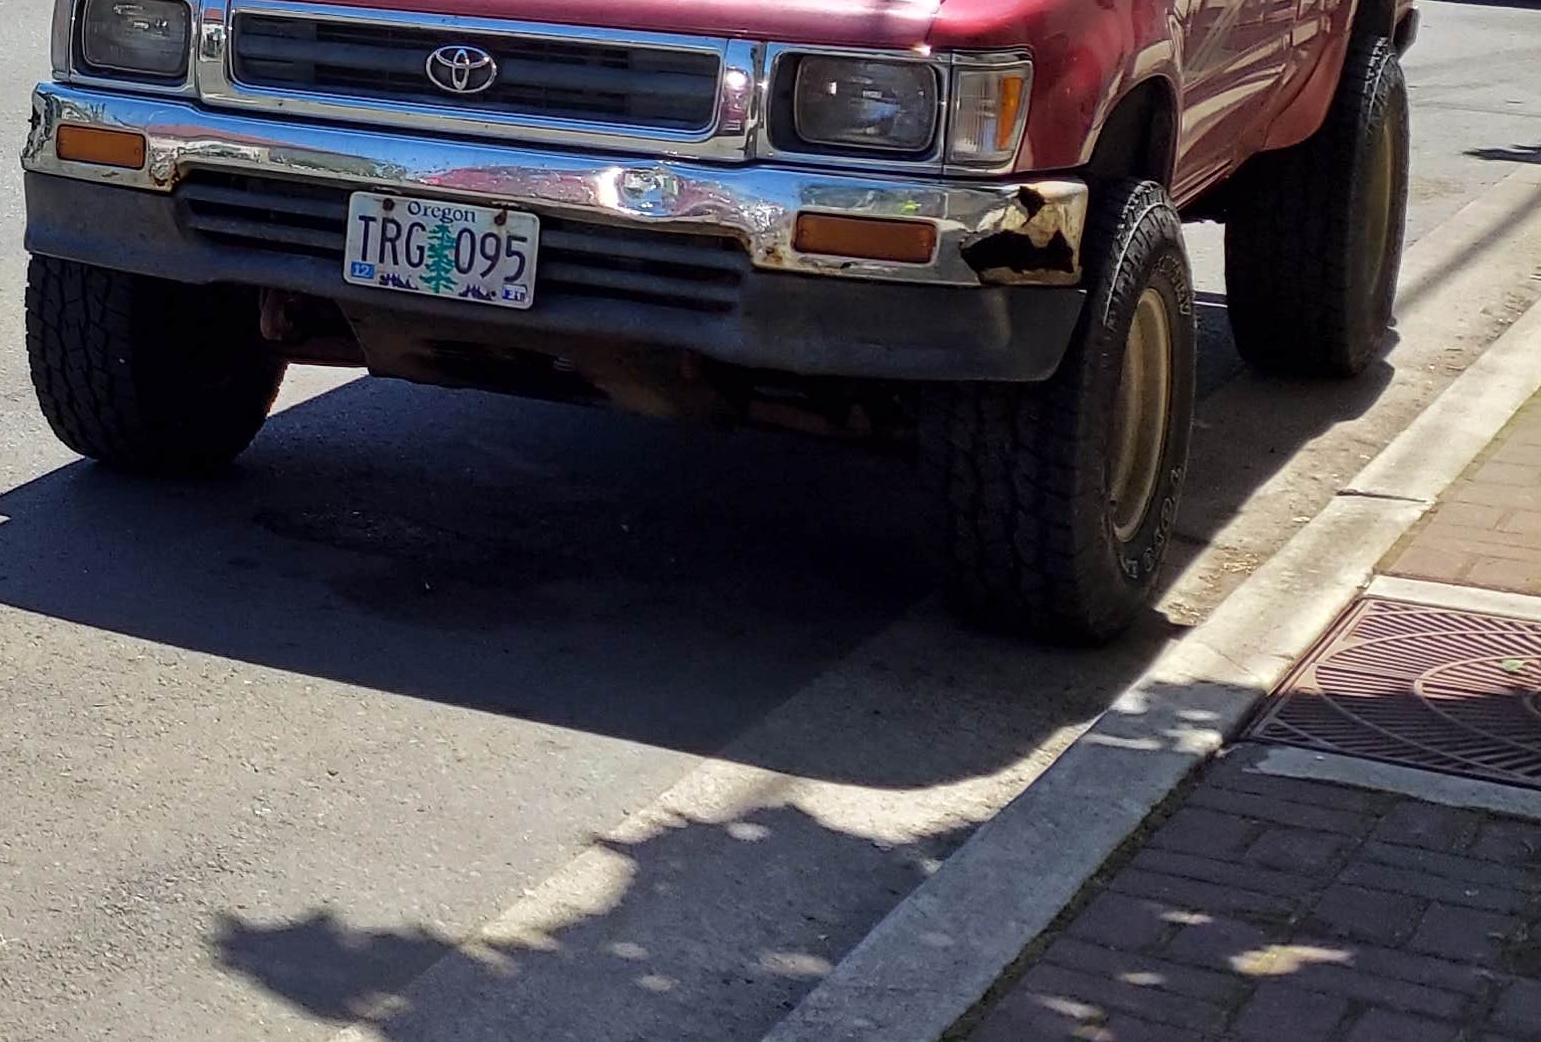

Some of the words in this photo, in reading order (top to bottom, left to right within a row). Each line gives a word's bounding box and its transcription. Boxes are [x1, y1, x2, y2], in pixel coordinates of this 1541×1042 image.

[407, 200, 477, 224] Oregon
[358, 214, 427, 269] TRG
[453, 227, 529, 283] 095
[353, 263, 369, 276] 12
